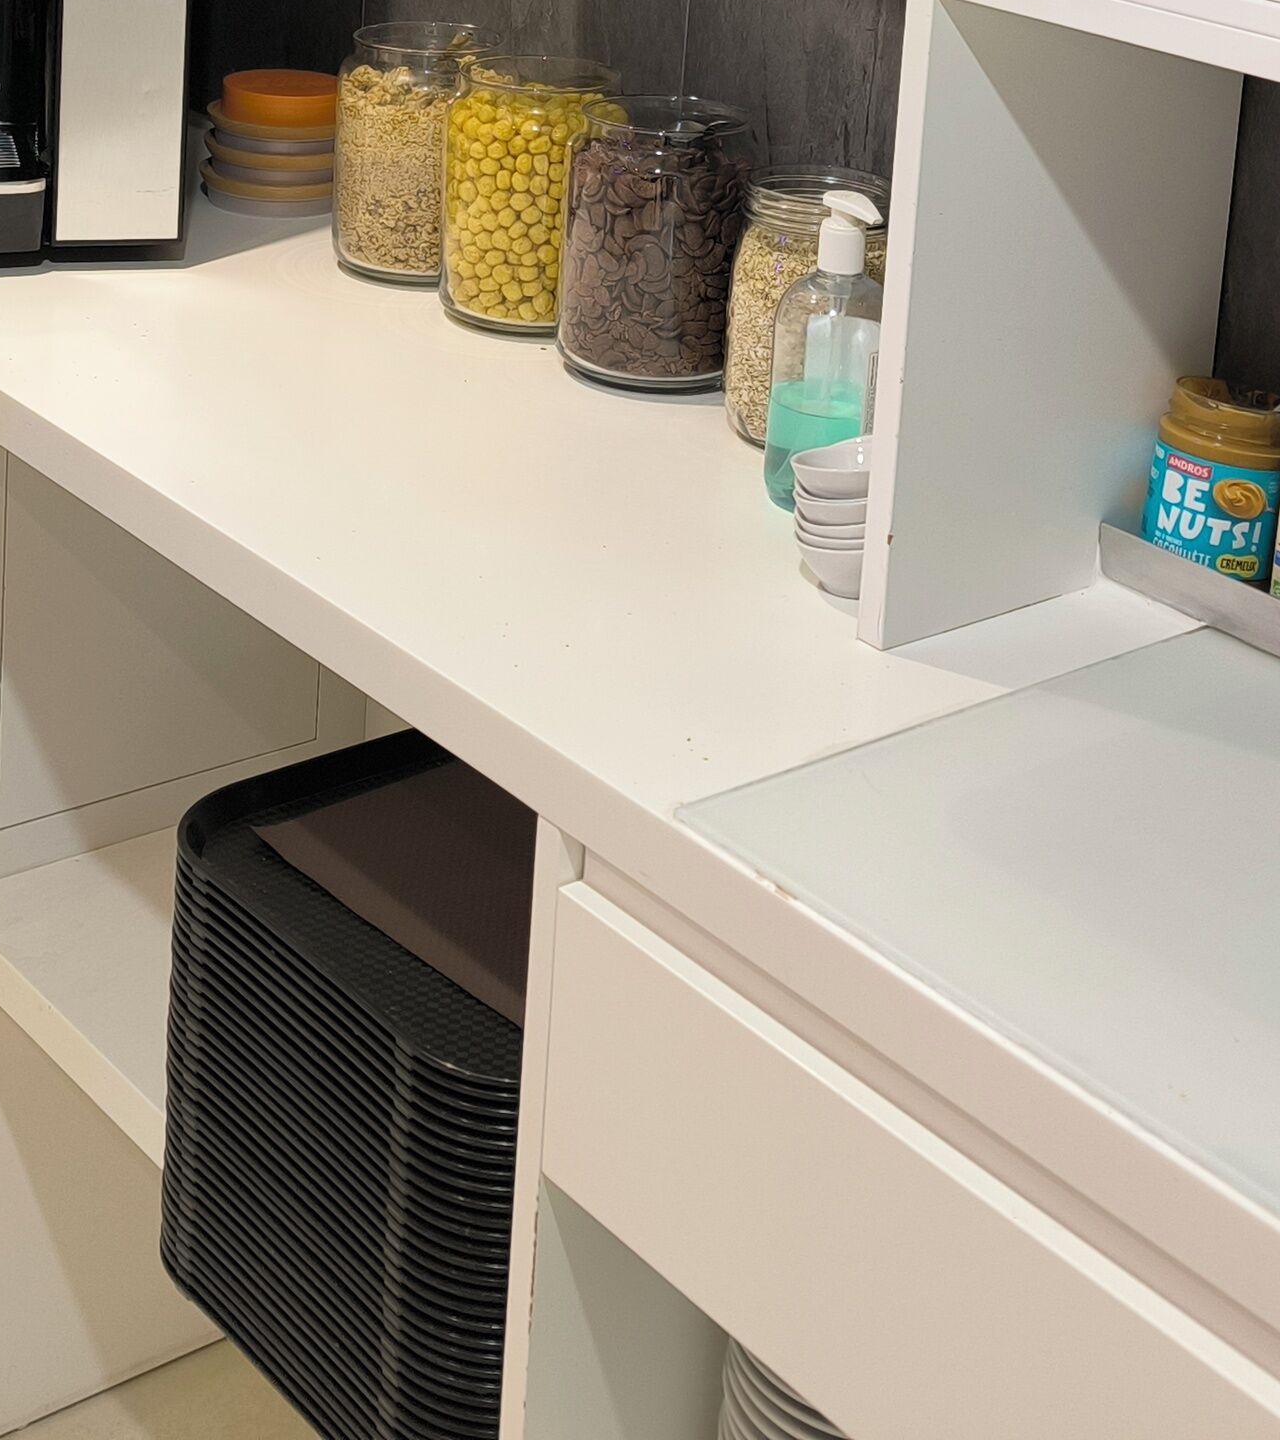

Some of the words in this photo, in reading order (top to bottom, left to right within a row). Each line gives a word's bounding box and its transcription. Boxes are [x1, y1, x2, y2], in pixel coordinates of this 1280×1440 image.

[1168, 455, 1210, 478] ANDROS
[1162, 469, 1210, 513] BE
[1220, 556, 1256, 573] CRÉMEUX
